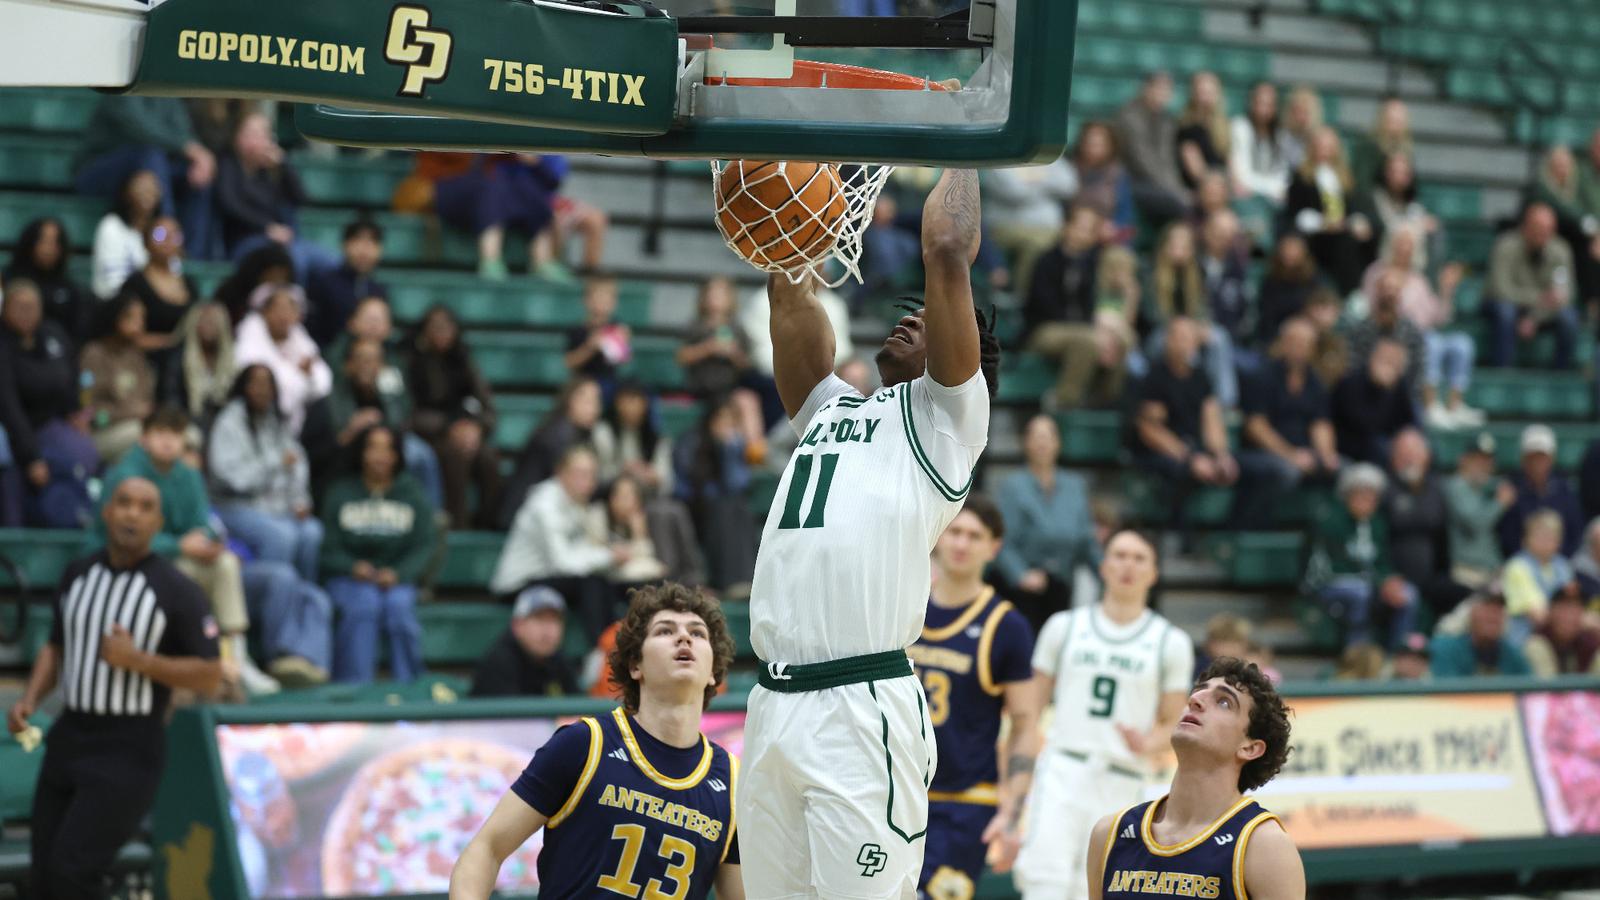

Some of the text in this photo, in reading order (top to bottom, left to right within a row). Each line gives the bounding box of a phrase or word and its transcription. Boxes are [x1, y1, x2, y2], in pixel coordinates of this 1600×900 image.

[178, 29, 366, 76] GOPOLY.COM
[383, 3, 452, 98] CP
[484, 58, 646, 107] 756-4TIX
[777, 453, 840, 530] 11
[1088, 674, 1117, 718] 9
[597, 783, 724, 842] ANTEATERS
[596, 822, 697, 900] 13
[1107, 869, 1221, 899] ANTEATERS
